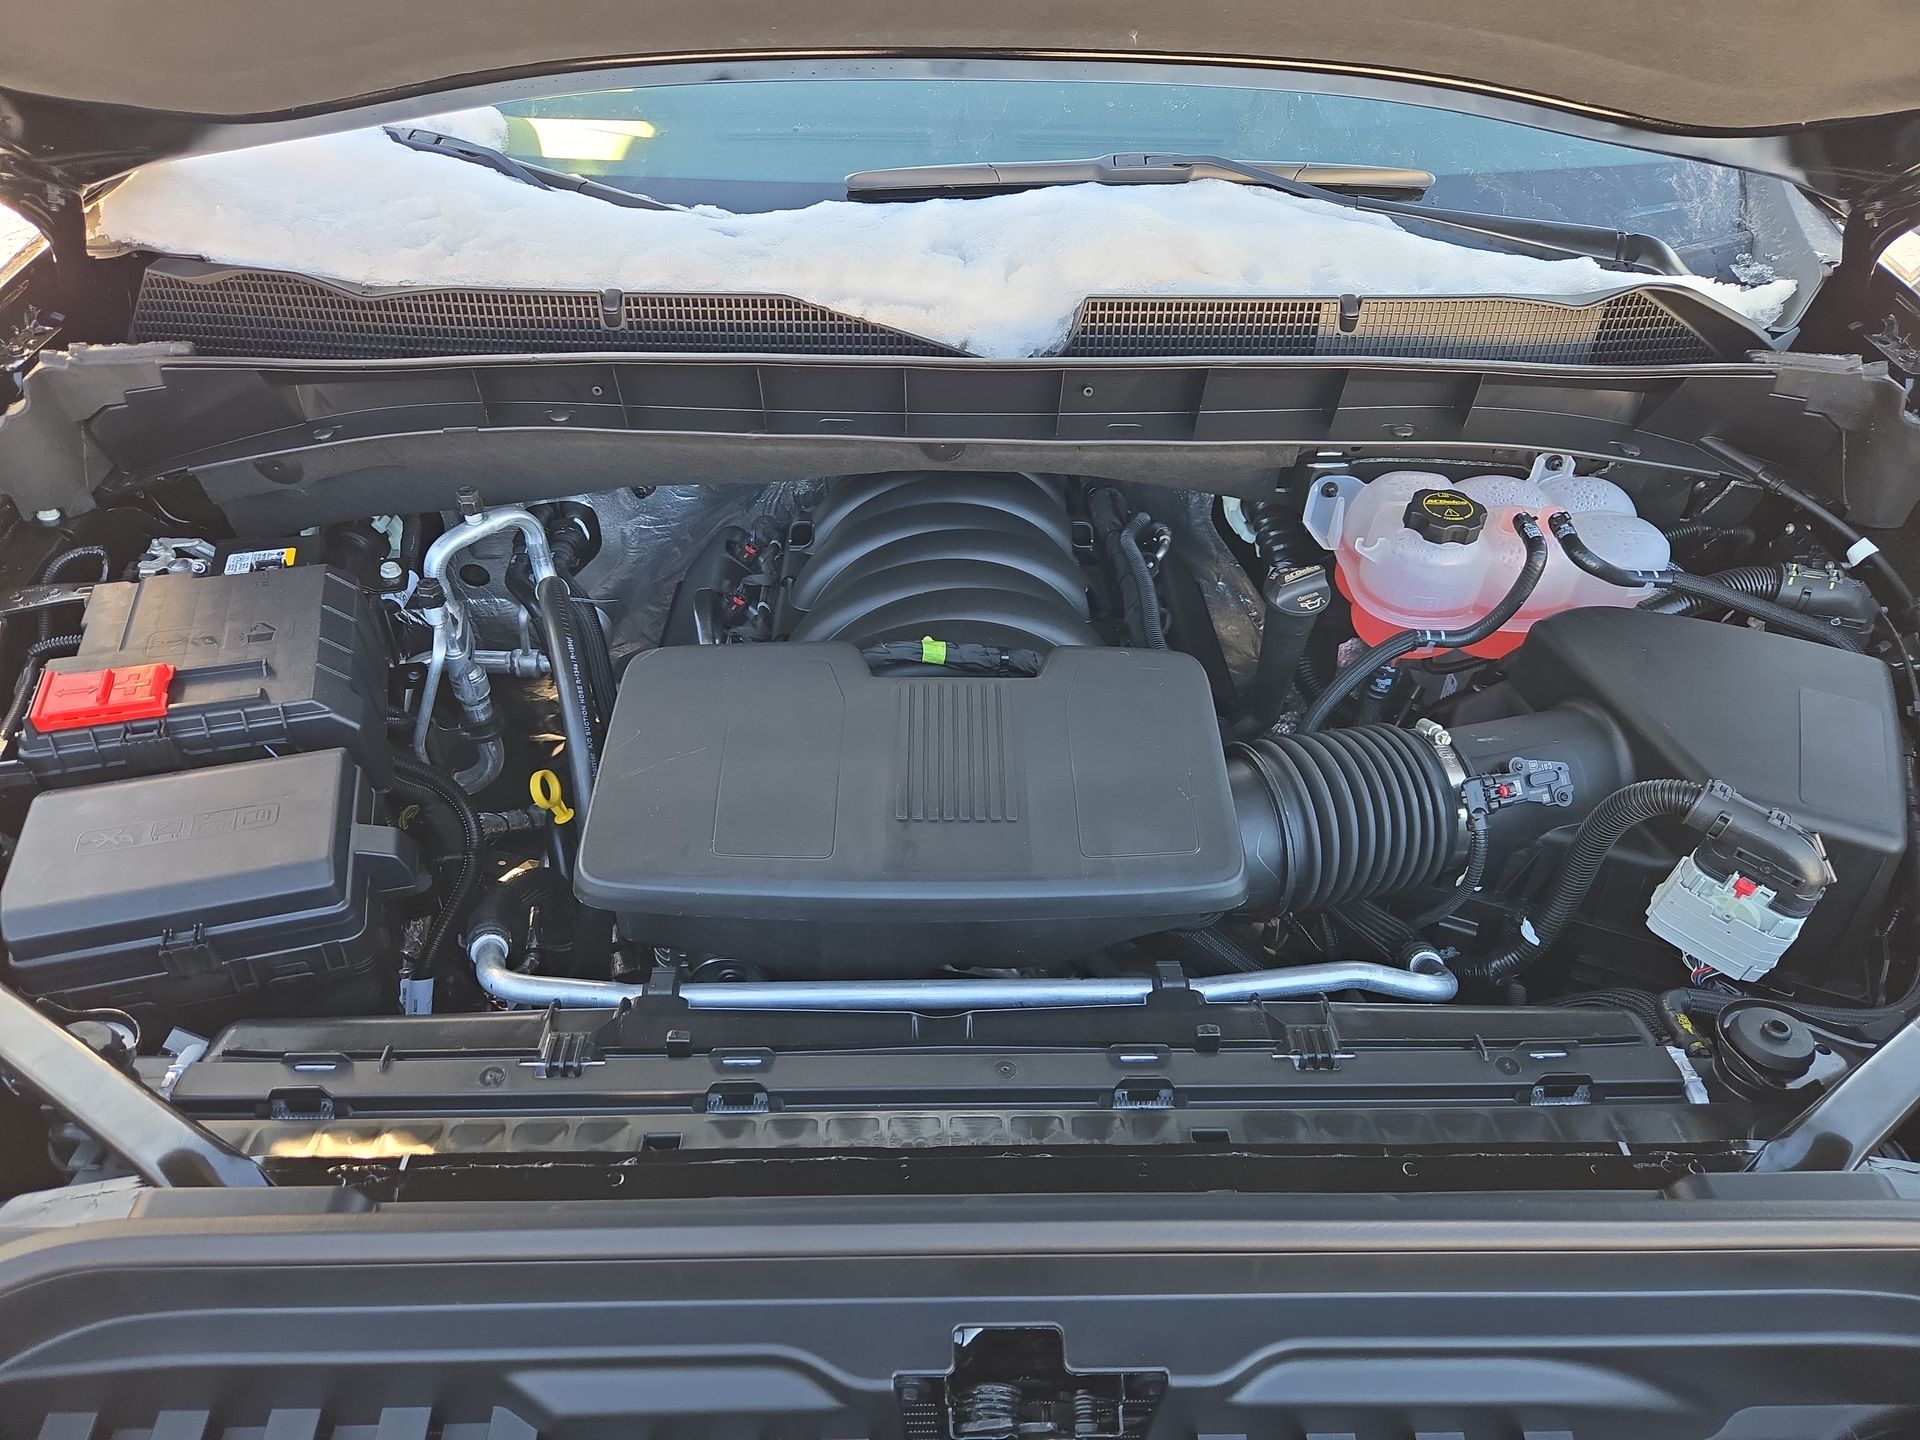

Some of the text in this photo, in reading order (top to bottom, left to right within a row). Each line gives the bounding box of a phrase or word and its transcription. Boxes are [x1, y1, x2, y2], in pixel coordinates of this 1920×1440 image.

[1284, 565, 1321, 582] ACDelco
[576, 685, 585, 704] HOSE
[581, 705, 592, 735] SUCTION
